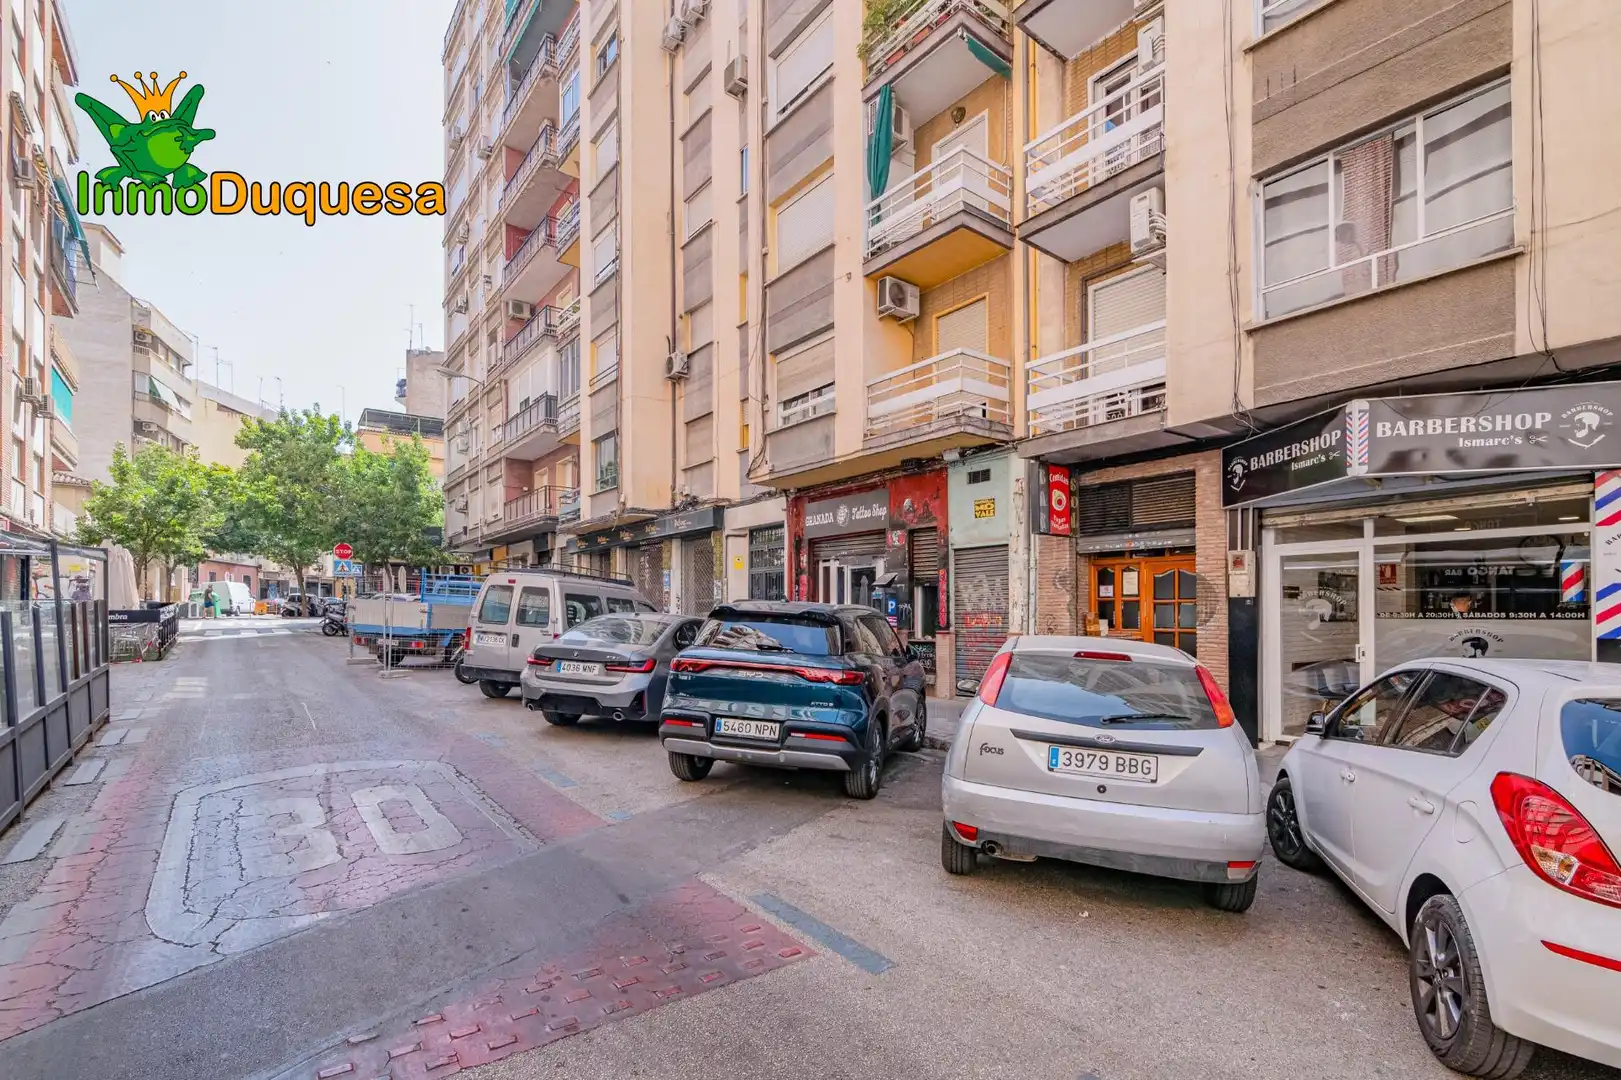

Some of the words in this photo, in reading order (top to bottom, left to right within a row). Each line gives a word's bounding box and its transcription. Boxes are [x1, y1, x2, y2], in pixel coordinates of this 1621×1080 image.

[1376, 412, 1552, 438] BARBERSHOP
[1459, 435, 1523, 448] Ismarc's
[1250, 430, 1342, 471] BARBERSHOP
[1291, 454, 1326, 471] Ismarc's
[805, 512, 834, 526] GRANADA
[852, 505, 871, 520] Tattoo
[872, 503, 887, 520] Shop
[888, 600, 896, 613] P
[562, 663, 580, 671] 4036
[583, 665, 597, 673] MNF
[723, 721, 752, 733] 5460
[755, 723, 777, 736] NPN
[1062, 751, 1109, 770] 3979
[1116, 756, 1151, 776] BBG
